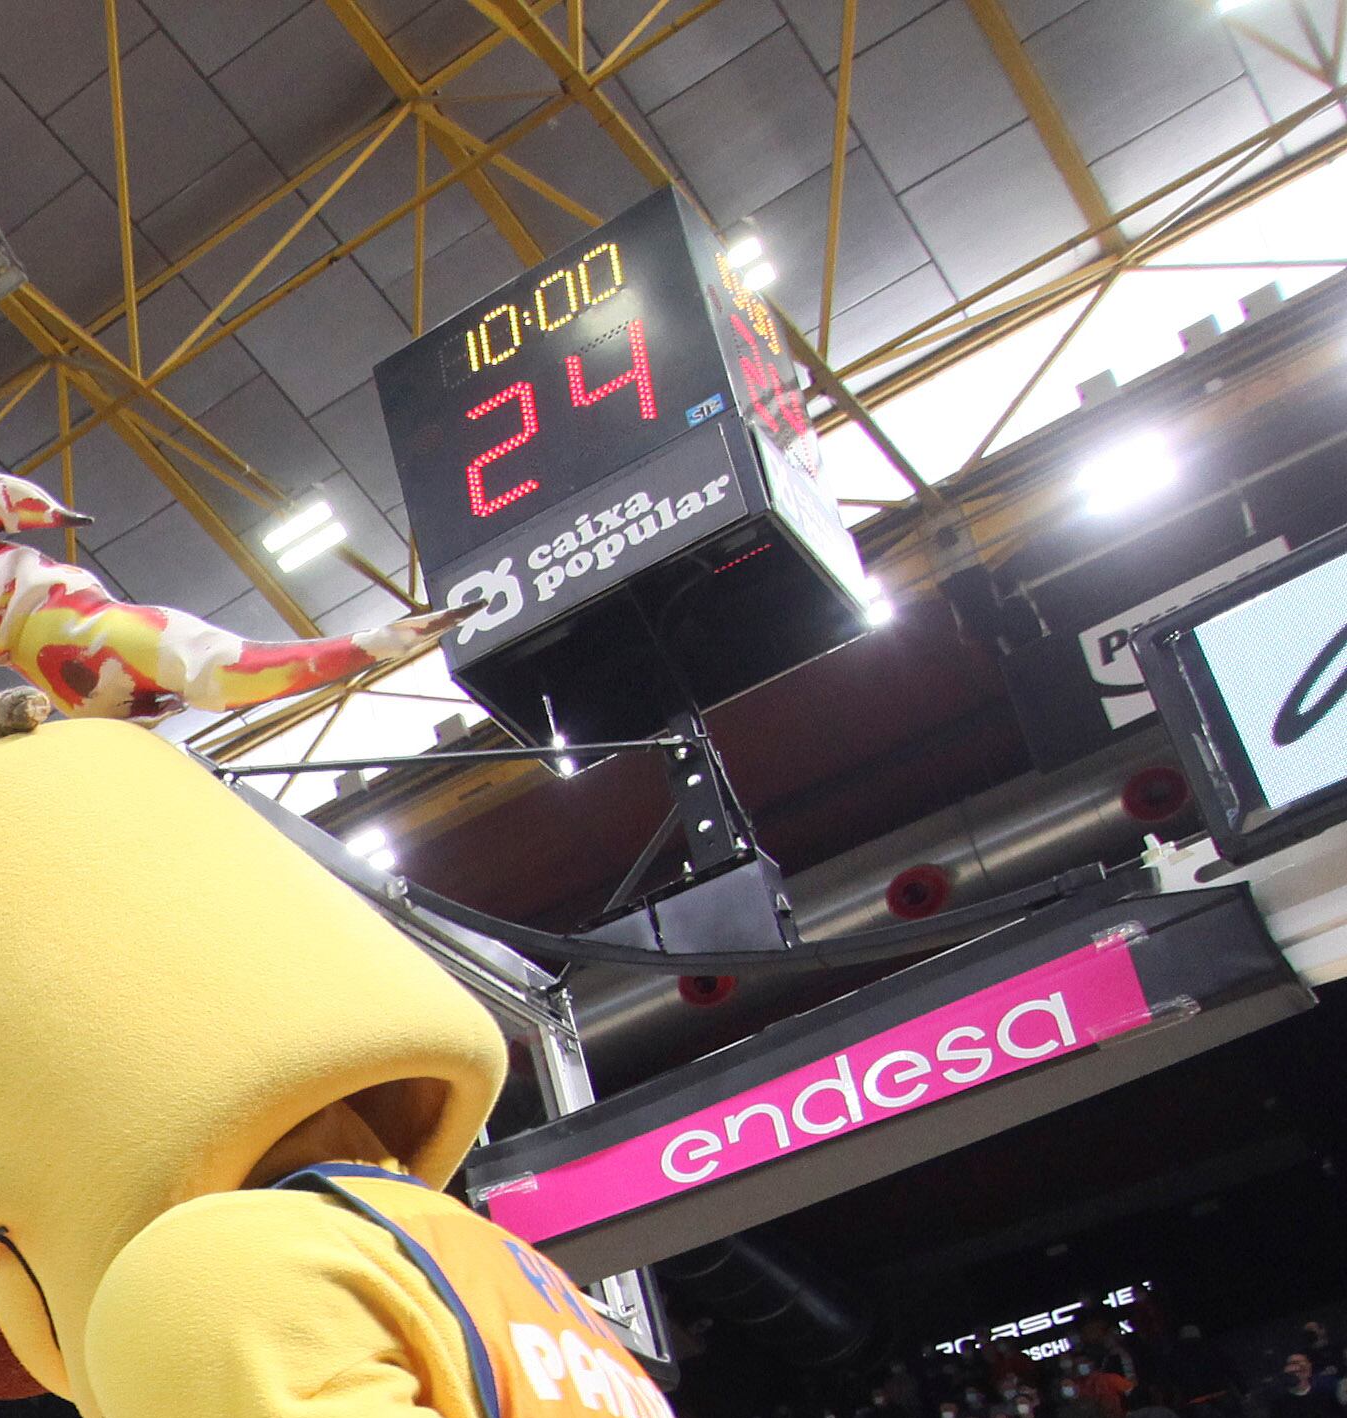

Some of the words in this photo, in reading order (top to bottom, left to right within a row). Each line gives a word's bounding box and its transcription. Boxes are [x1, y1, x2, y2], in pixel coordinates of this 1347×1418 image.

[466, 242, 624, 372] 10:00
[464, 318, 657, 518] 24
[527, 489, 654, 571] caixa
[534, 474, 731, 602] popular
[661, 992, 1076, 1184] endesa
